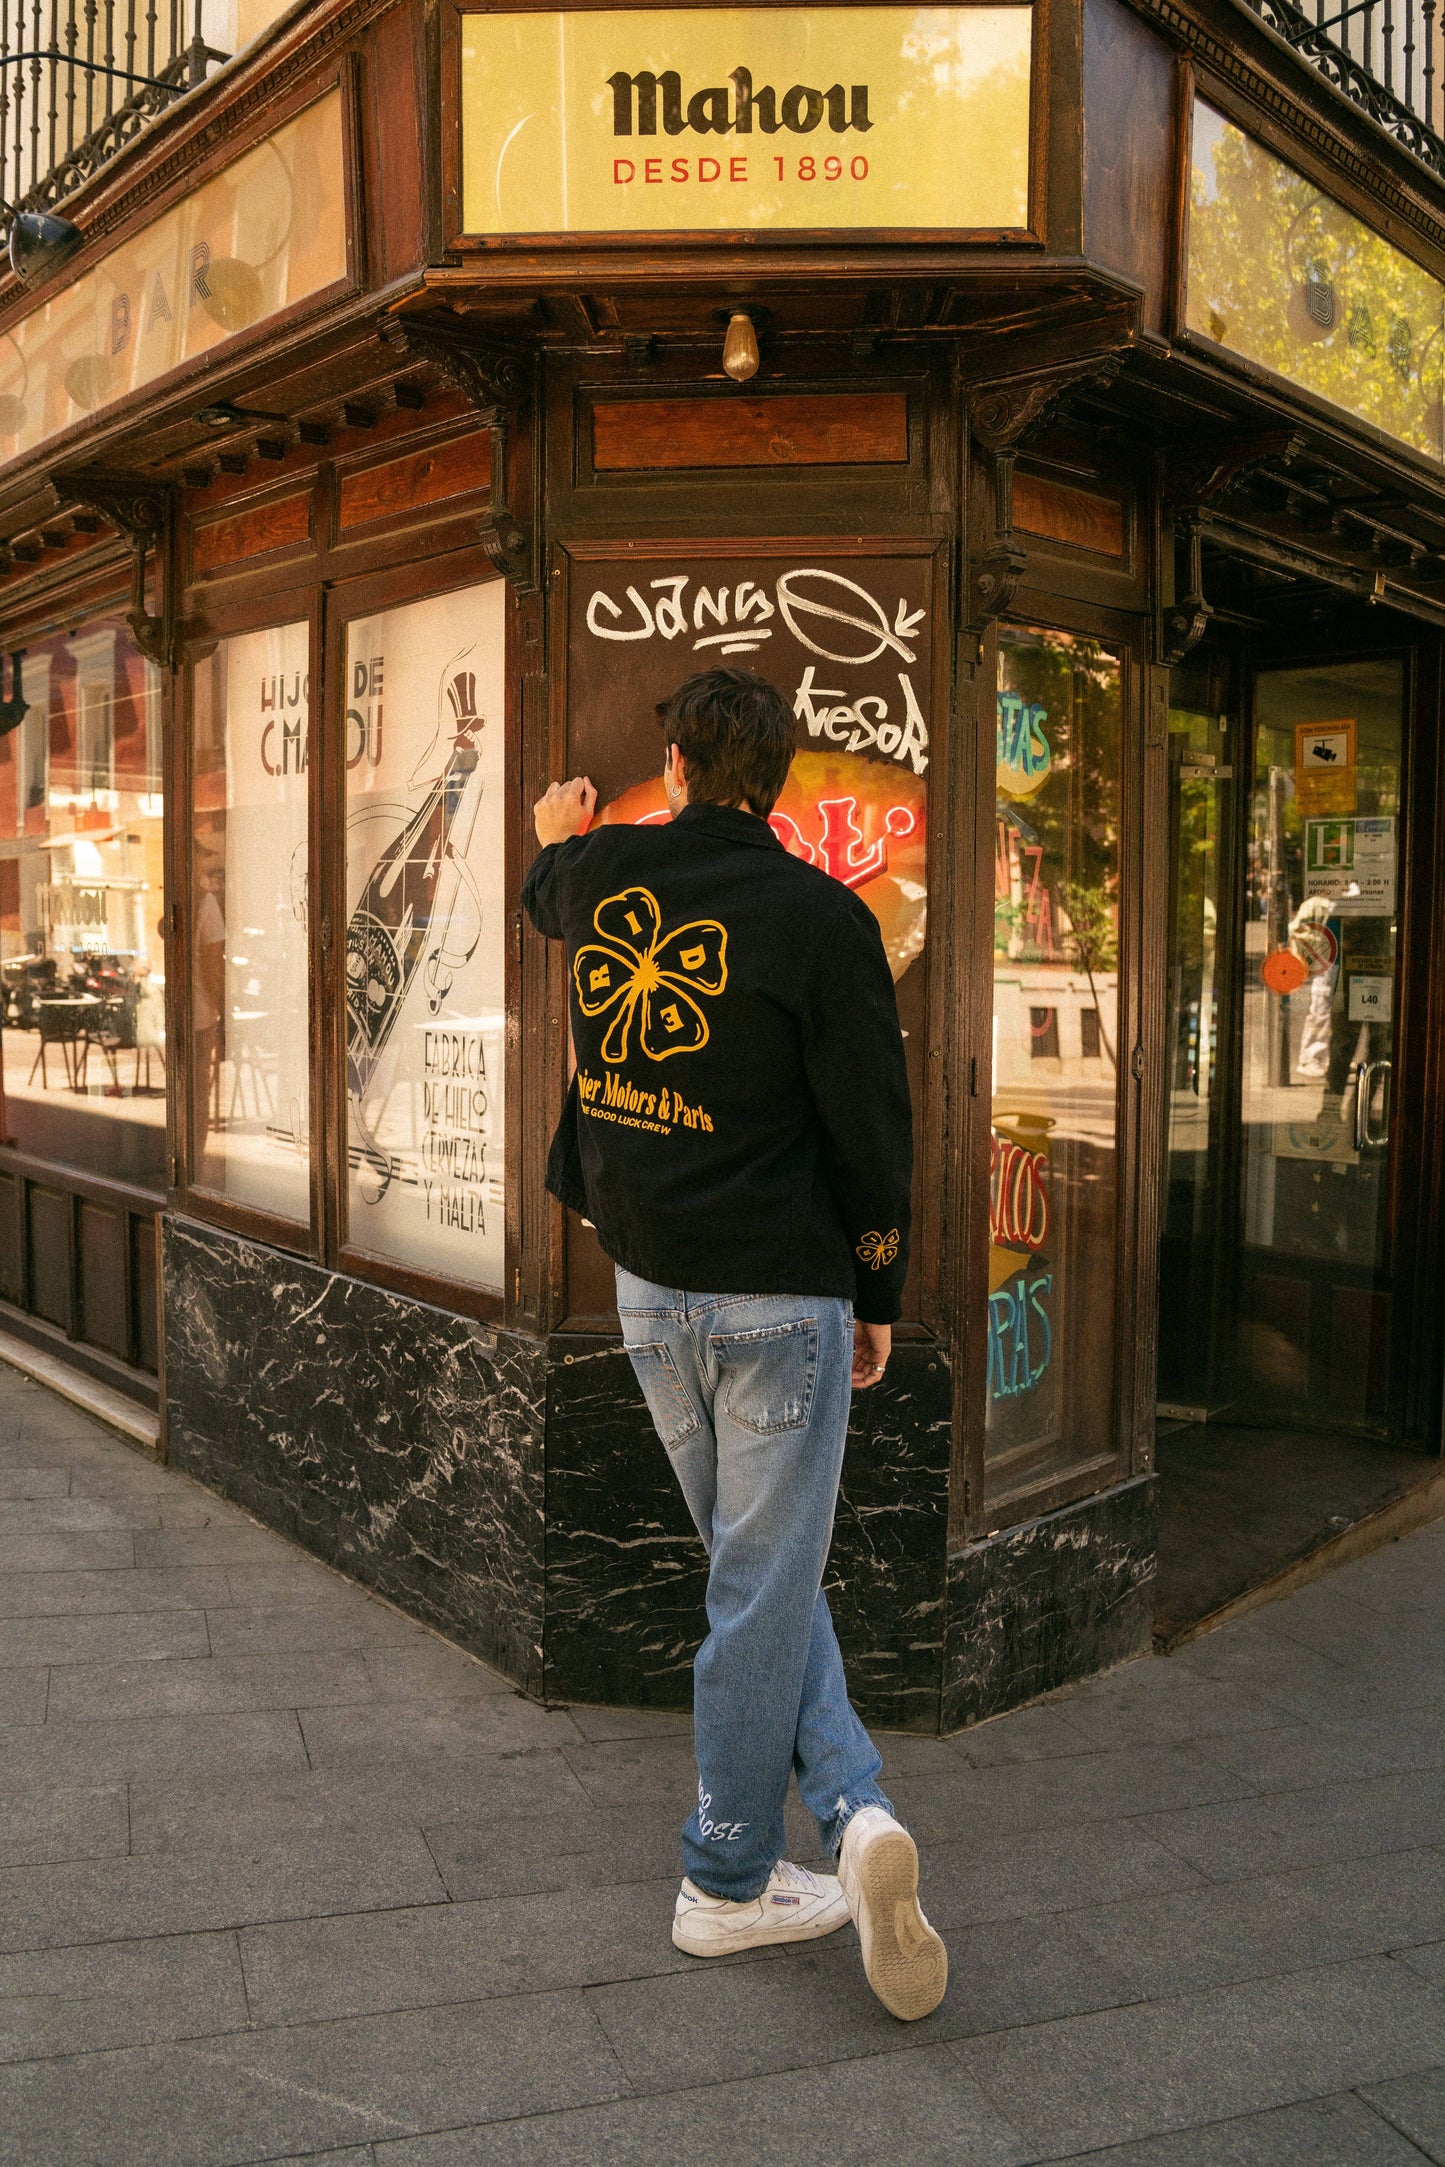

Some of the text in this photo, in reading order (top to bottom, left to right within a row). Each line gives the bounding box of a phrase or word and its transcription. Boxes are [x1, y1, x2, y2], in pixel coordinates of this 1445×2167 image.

[605, 66, 875, 136] Mahou
[613, 155, 869, 184] DESDE 1890
[112, 241, 213, 355] BAR
[1306, 257, 1412, 381] BAR
[354, 657, 384, 699] DE
[1312, 825, 1352, 867] H
[1361, 995, 1378, 1005] L40
[425, 1031, 486, 1081] FABRICA
[424, 1081, 488, 1134] DE HIELO
[590, 1107, 617, 1122] GOOD
[618, 1114, 641, 1128] LUCK
[641, 1120, 671, 1136] CREW
[601, 1070, 657, 1115] Motors
[658, 1087, 670, 1120] &
[672, 1091, 714, 1133] Parts
[422, 1131, 487, 1184] CERVEZAS
[424, 1179, 486, 1236] Y MALTA
[699, 1806, 750, 1841] LOSE
